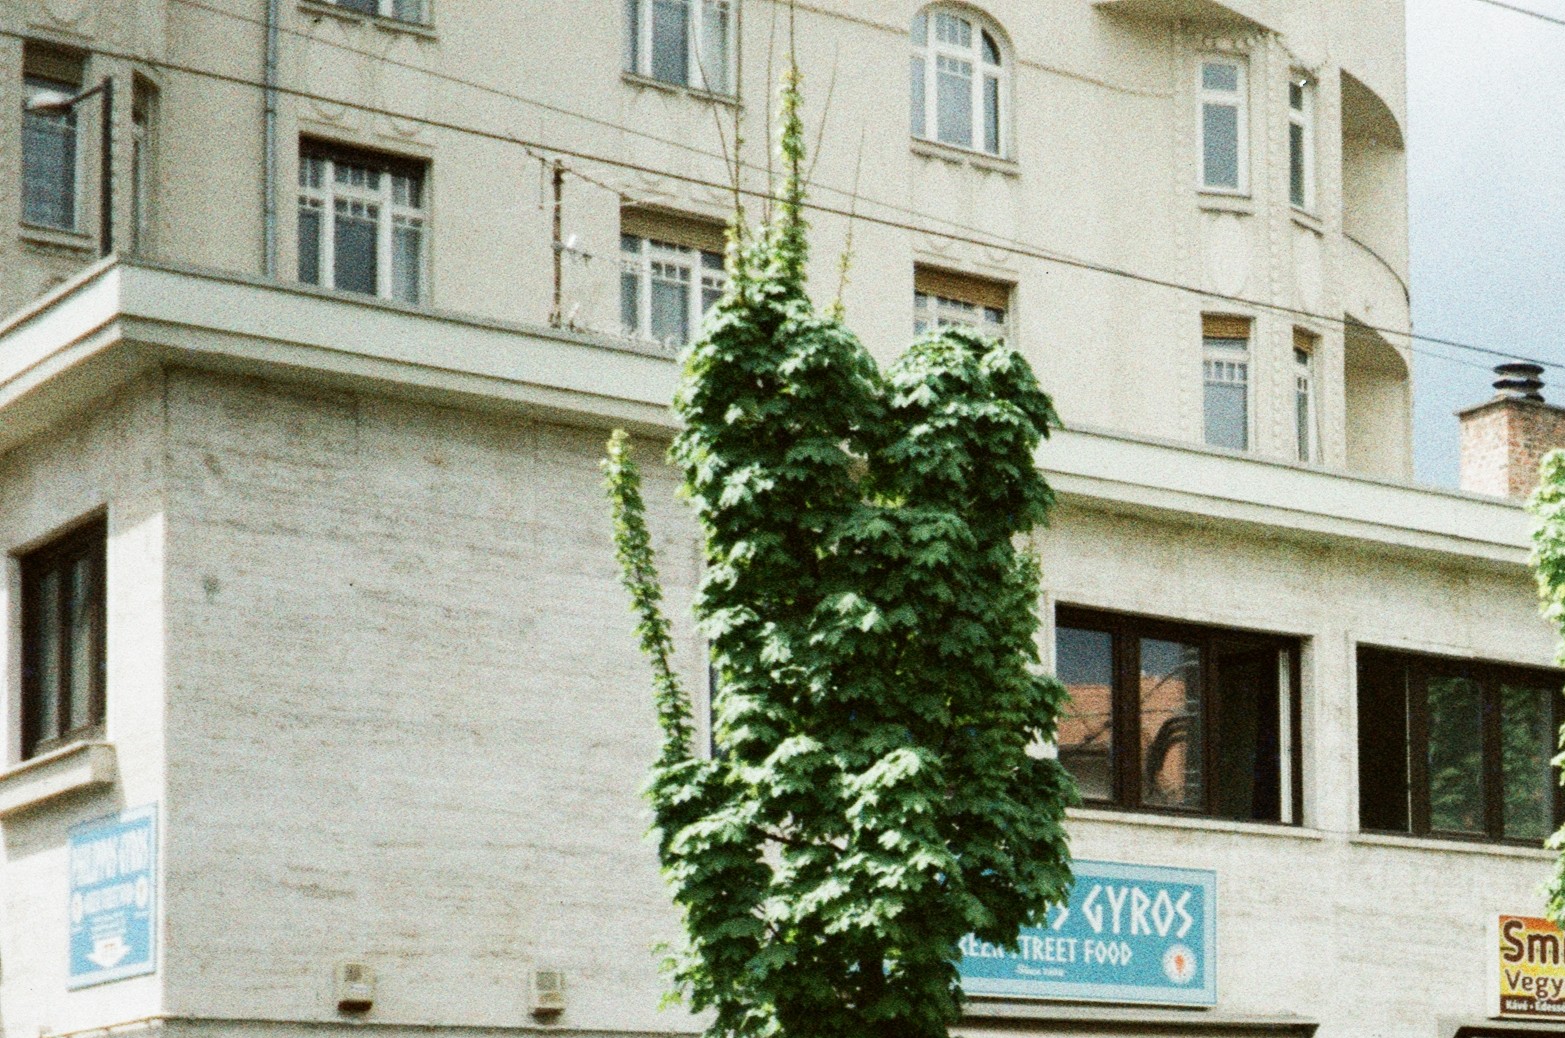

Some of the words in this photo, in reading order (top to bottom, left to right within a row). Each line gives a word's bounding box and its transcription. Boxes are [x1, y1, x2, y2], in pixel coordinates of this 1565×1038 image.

[1082, 884, 1193, 938] GYROS
[1011, 935, 1078, 963] TREET
[1084, 939, 1133, 966] FOOD
